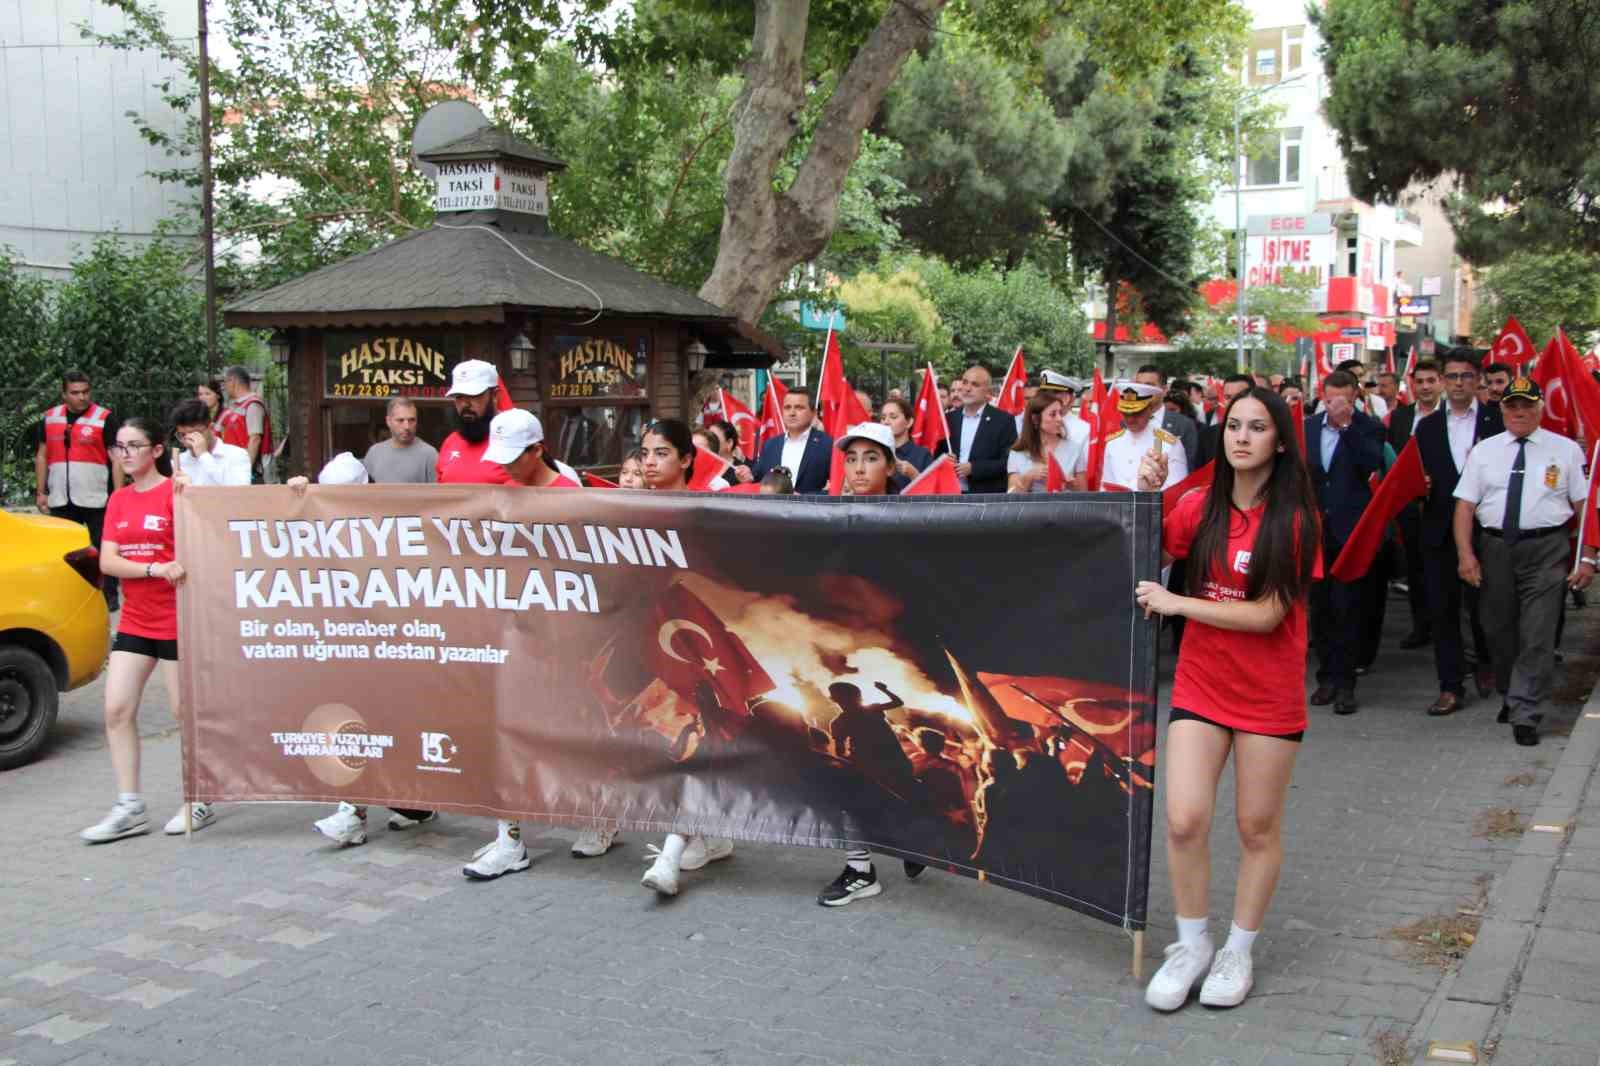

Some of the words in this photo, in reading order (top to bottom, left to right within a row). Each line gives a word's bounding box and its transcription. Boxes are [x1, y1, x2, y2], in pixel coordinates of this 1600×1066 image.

[439, 162, 492, 176] HASTANE
[503, 166, 544, 181] HASTANE
[472, 196, 480, 207] 22
[528, 200, 535, 211] 22
[1270, 217, 1306, 230] EGE
[341, 336, 446, 381] HASTANE
[560, 339, 635, 380] HASTANE
[334, 383, 354, 396] 217
[358, 384, 372, 396] 22
[375, 384, 390, 397] 89
[568, 384, 582, 396] 22
[228, 516, 429, 559] TÜRKİYE
[432, 517, 688, 569] YÜZYILININ
[233, 566, 600, 613] KAHRAMANLARI
[240, 620, 268, 637] Bir
[273, 619, 321, 640] olan,
[324, 619, 398, 637] beraber
[402, 619, 446, 641] olan,
[242, 642, 298, 659] vatan
[303, 641, 369, 661] uğruna
[374, 641, 435, 660] destan
[439, 645, 509, 664] yazanlar
[283, 743, 384, 759] KAHRAMANLARI
